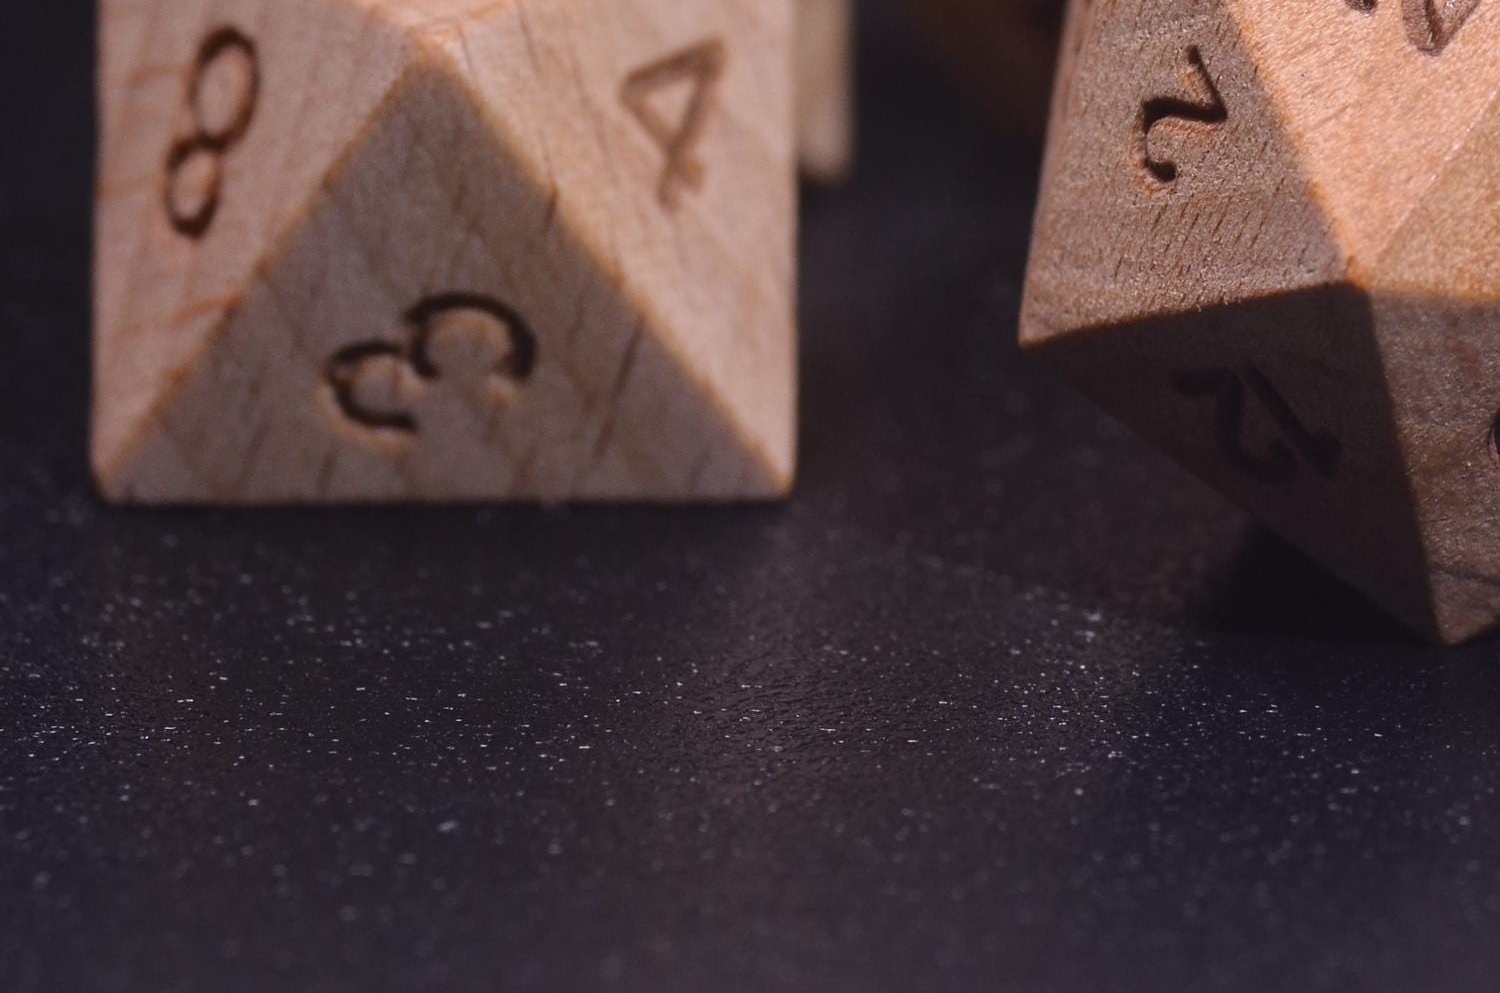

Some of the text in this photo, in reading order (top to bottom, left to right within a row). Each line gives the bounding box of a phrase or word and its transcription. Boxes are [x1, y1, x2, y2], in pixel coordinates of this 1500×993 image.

[163, 24, 262, 242] 8
[618, 36, 728, 210] 4
[1130, 44, 1230, 184] 2
[324, 290, 540, 436] 3
